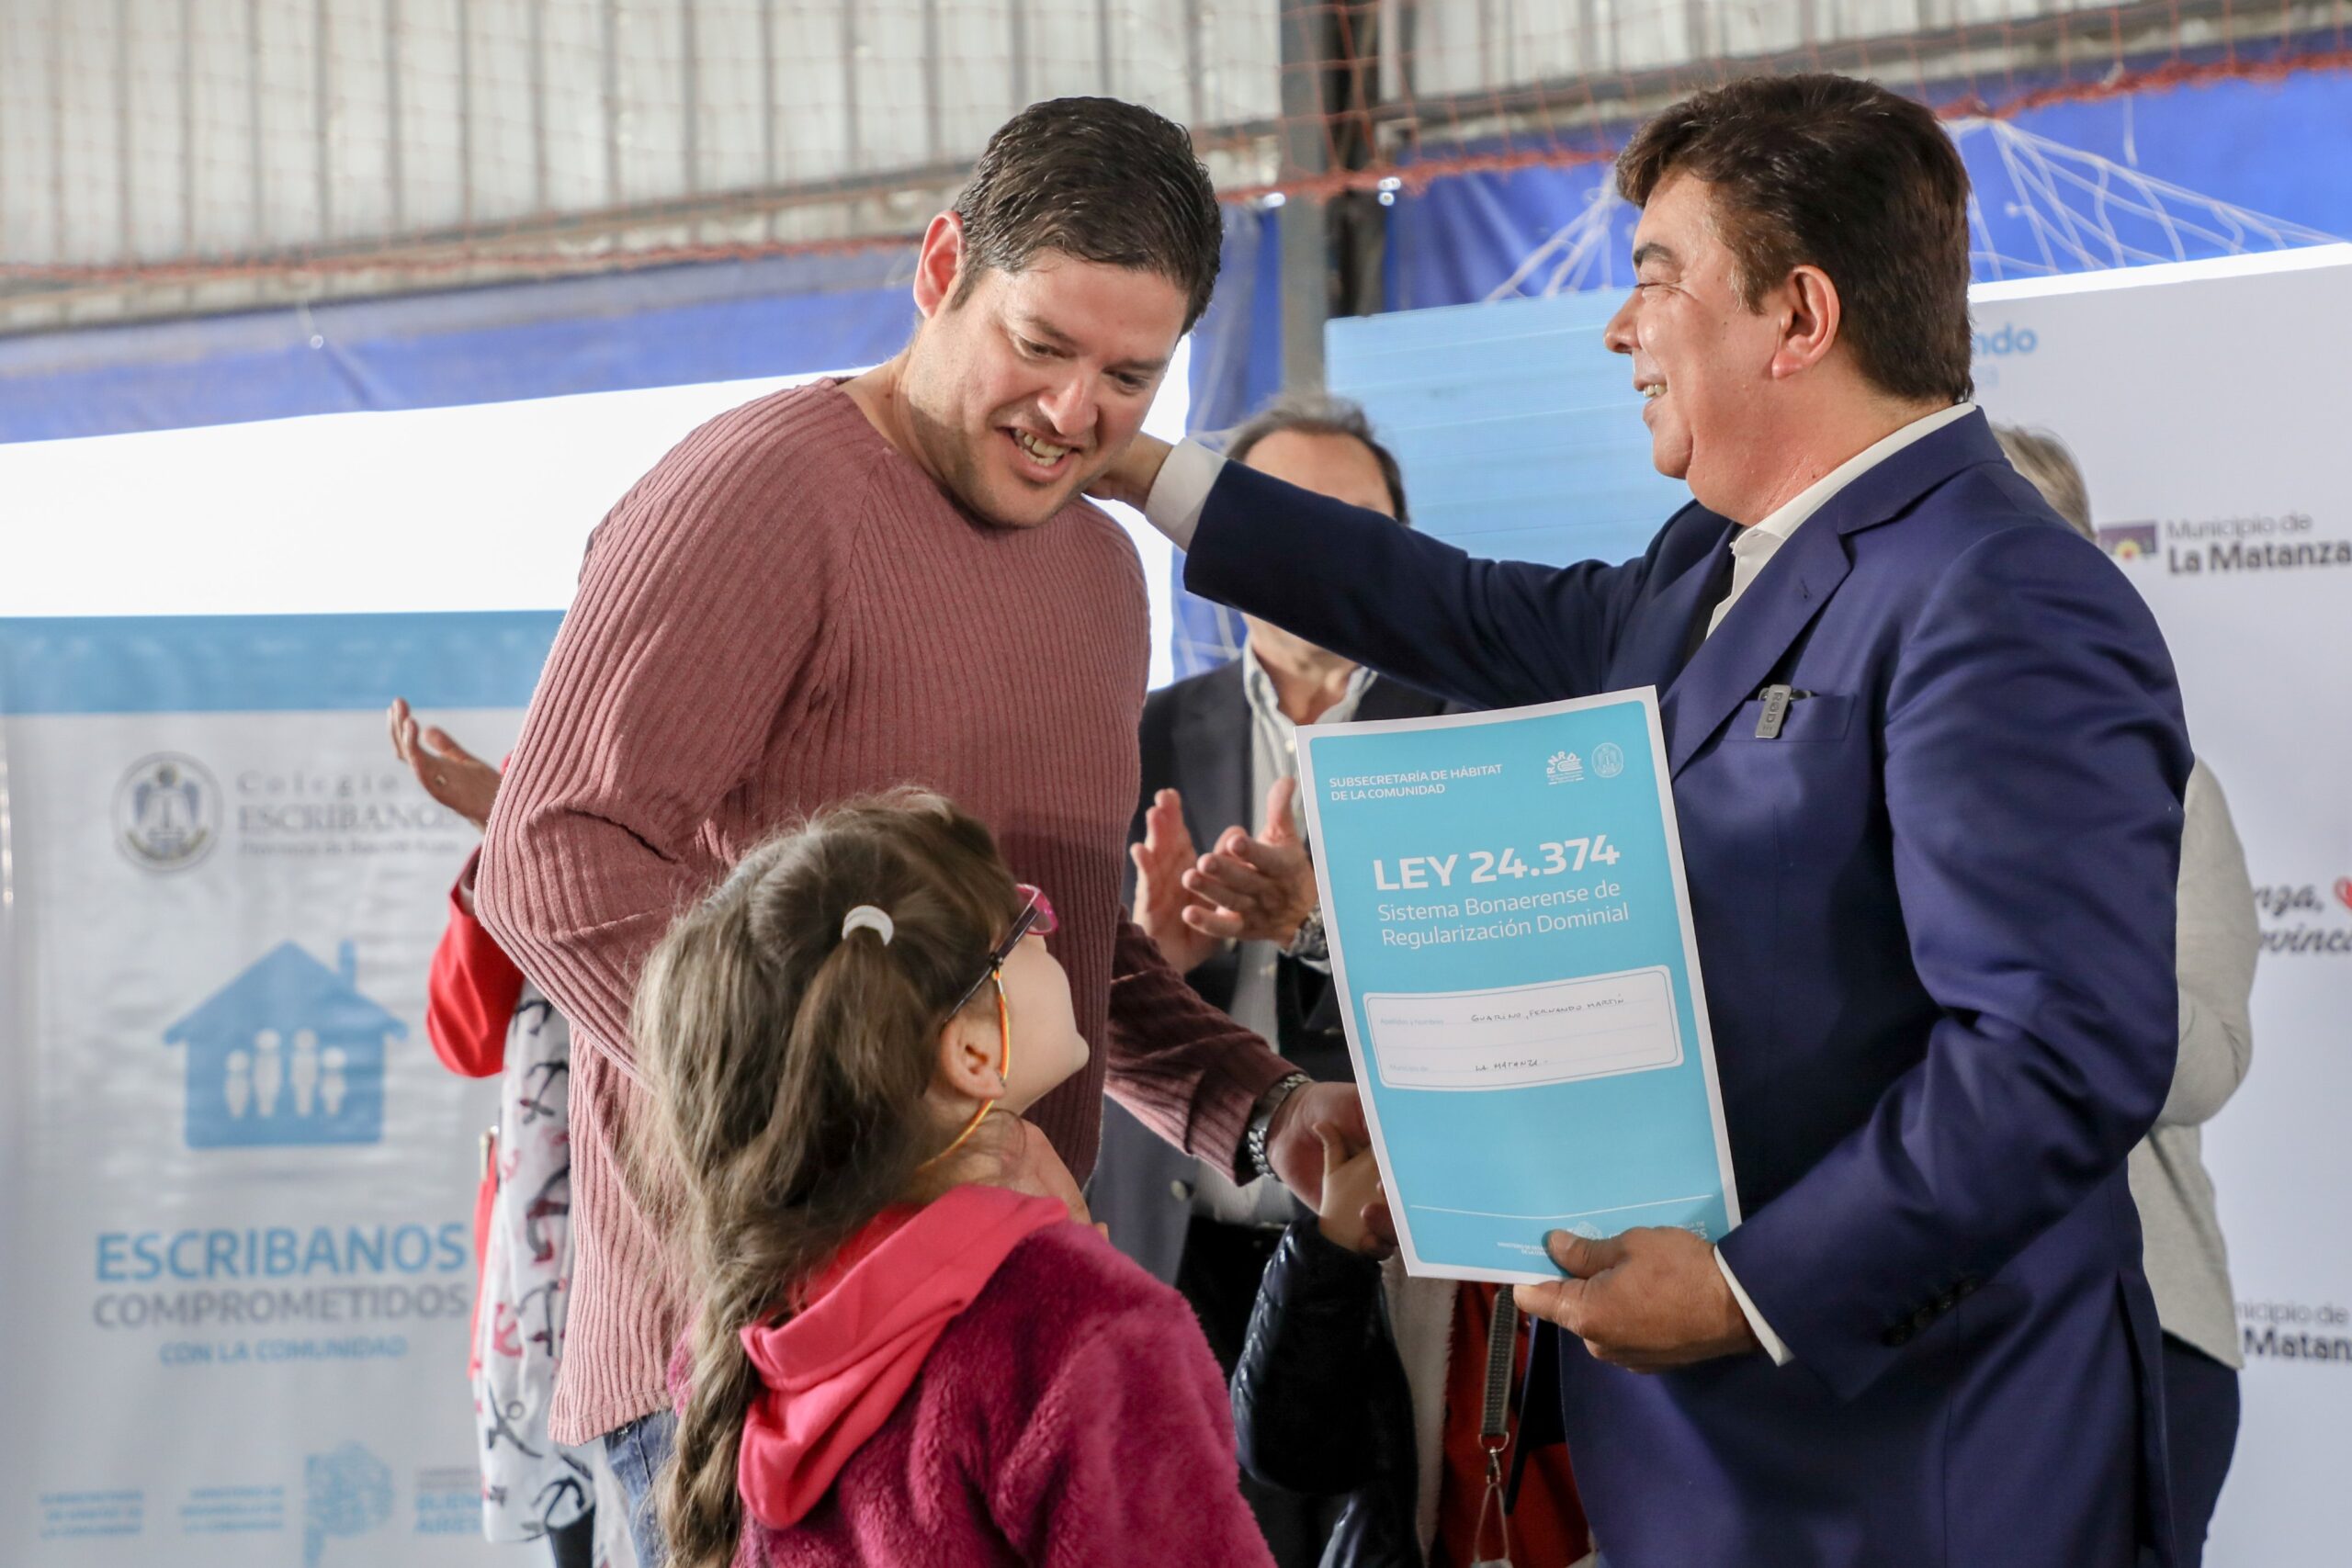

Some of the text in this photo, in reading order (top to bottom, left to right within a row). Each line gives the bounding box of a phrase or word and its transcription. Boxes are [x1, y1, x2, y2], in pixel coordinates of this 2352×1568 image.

[1973, 322, 2038, 355] ndo
[2280, 512, 2313, 535] de
[2169, 541, 2352, 574] La Matanza
[1329, 764, 1502, 788] SUBSECRETARÍA DE HÁBITAT
[1331, 784, 1445, 801] DE LA COMUNIDAD
[1374, 835, 1621, 890] LEY 24.374
[1378, 880, 1621, 921] Sistema Bonaerense de
[1382, 903, 1629, 950] Regularización Dominial
[96, 1223, 467, 1280] ESCRIBANOS
[93, 1284, 468, 1328] COMPROMETIDOS
[2236, 1299, 2311, 1324] nicipio
[160, 1337, 407, 1364] CON LA COMUNIDAD
[2245, 1326, 2351, 1359] Matan
